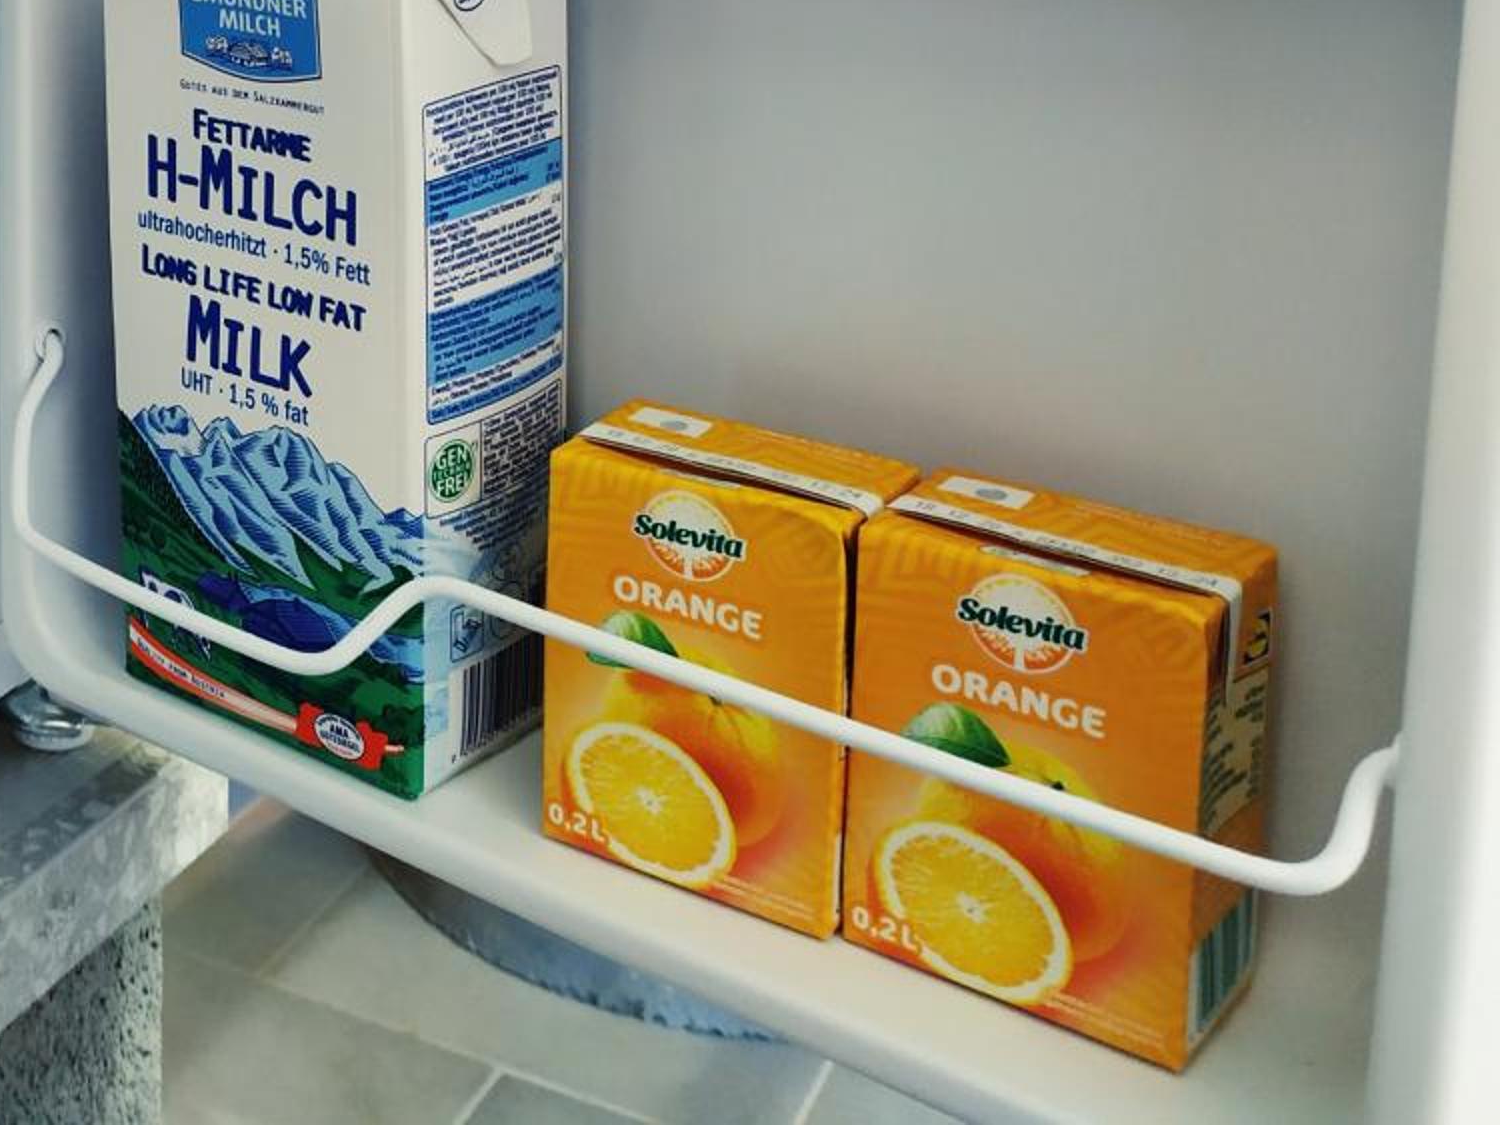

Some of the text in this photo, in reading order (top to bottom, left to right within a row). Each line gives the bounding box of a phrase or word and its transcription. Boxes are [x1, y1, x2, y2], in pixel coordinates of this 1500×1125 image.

[219, 9, 281, 38] MILCH
[193, 107, 313, 162] FETTARME
[148, 133, 357, 246] H-MILCH
[138, 211, 372, 286] ultrahocherhitzt 1,5% Fett
[142, 243, 367, 332] LONG LIFE LOW FAT
[187, 294, 313, 398] MILK
[181, 367, 213, 395] UHT
[229, 383, 255, 410] 1,5
[285, 400, 309, 426] fat
[436, 446, 467, 469] GEN
[634, 514, 743, 558] Solevita
[613, 575, 763, 640] ORANGE
[958, 598, 1086, 650] Solevita
[931, 664, 1107, 739] ORANGE
